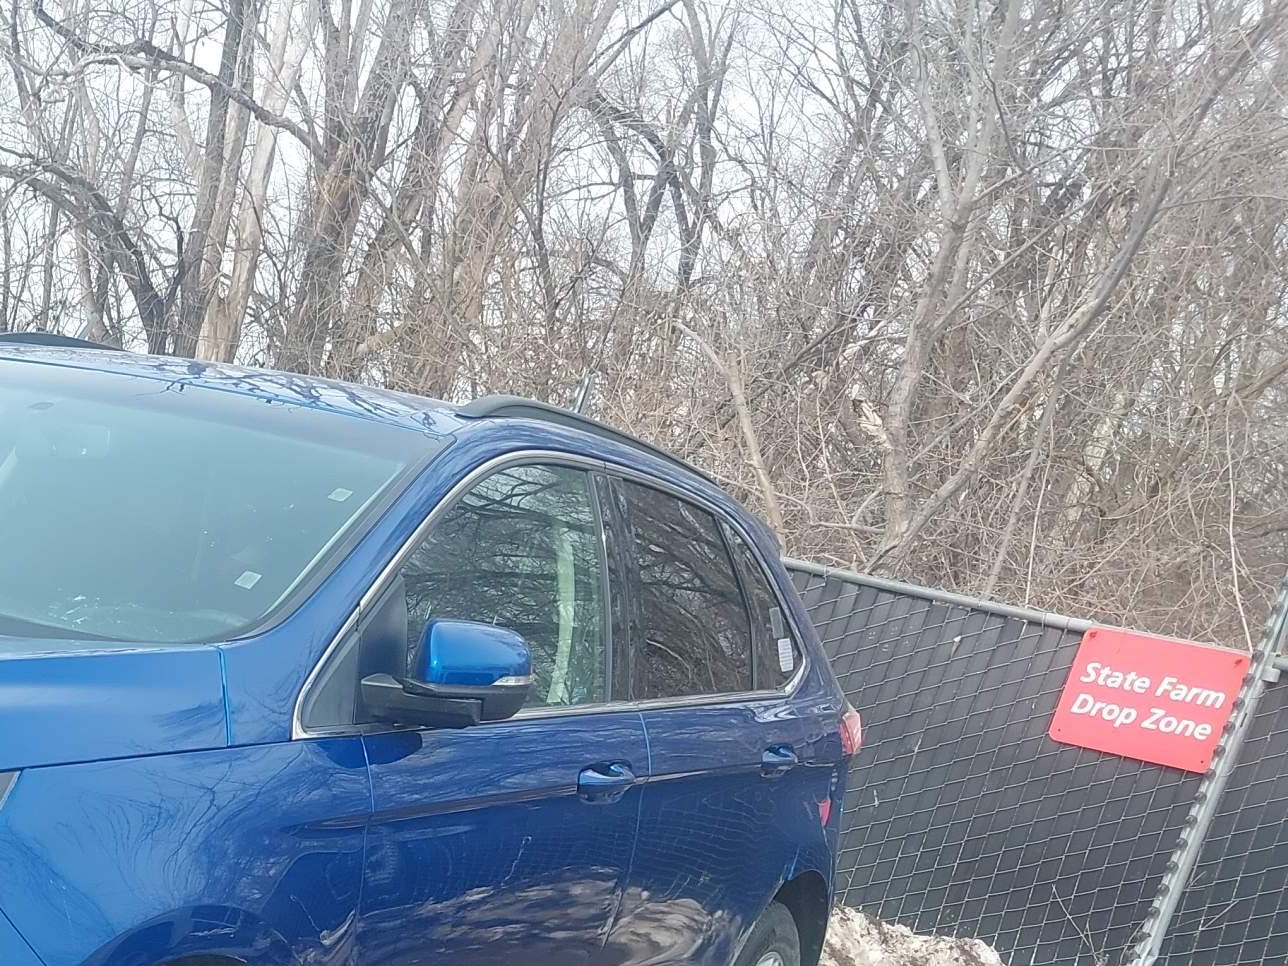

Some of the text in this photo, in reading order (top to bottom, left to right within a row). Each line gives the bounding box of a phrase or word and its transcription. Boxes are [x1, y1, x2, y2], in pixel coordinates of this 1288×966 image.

[1080, 662, 1226, 709] State Farm
[1070, 694, 1213, 741] Drop Zone
